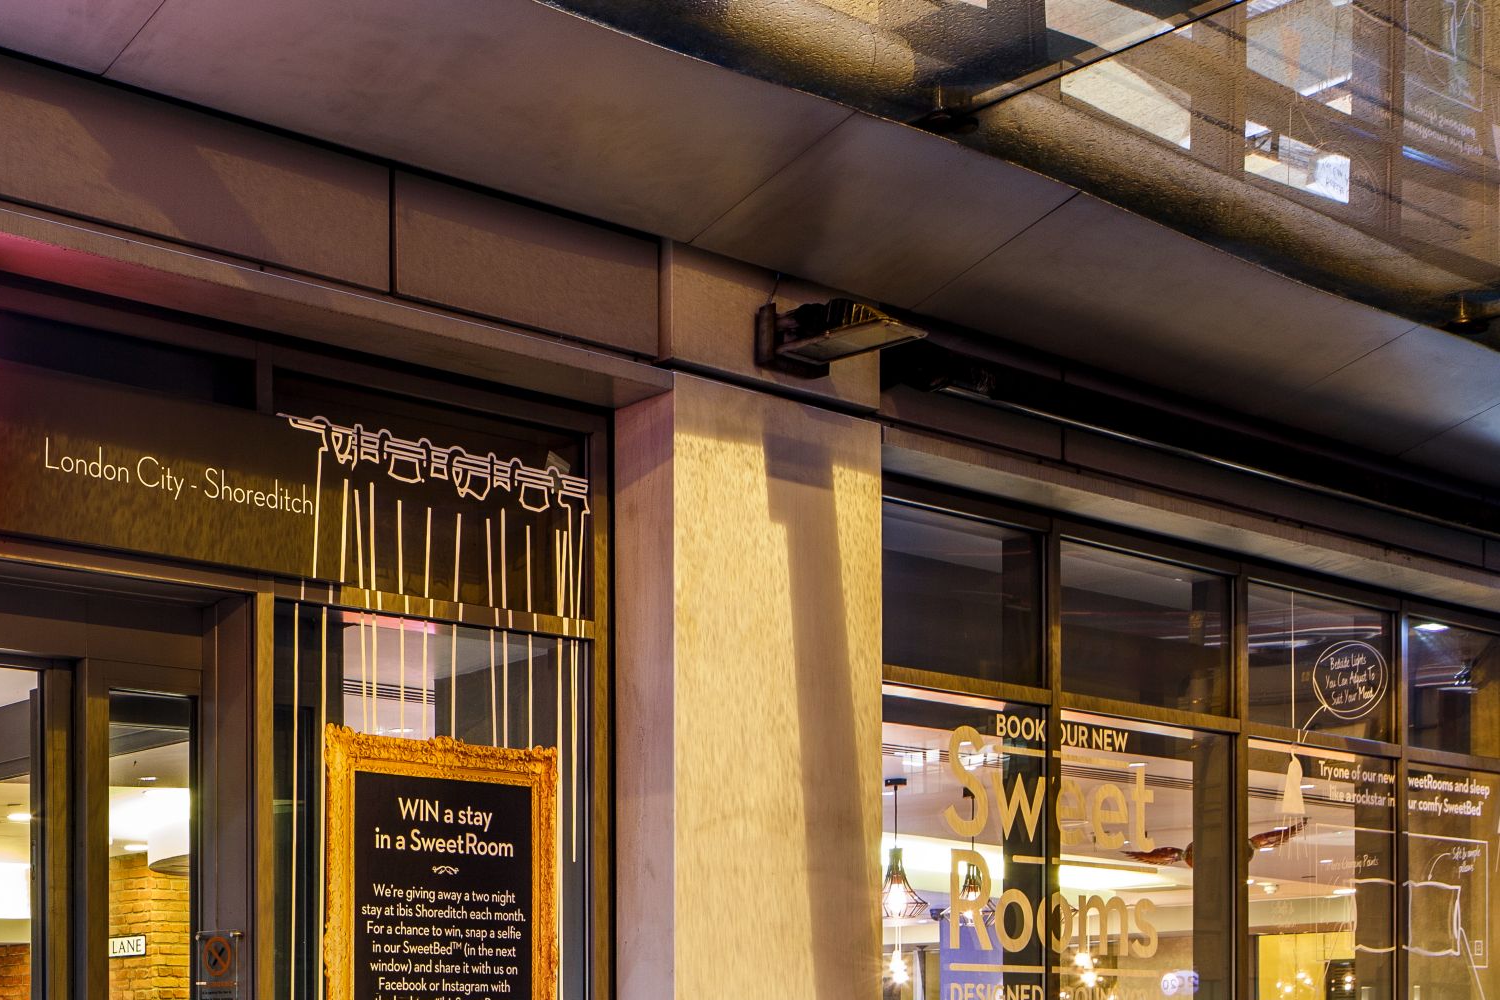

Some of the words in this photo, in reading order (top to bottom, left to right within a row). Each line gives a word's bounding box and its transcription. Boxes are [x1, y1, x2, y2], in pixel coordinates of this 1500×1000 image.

[45, 437, 130, 483] London
[137, 457, 184, 500] City
[204, 469, 314, 516] Shoreditch
[1352, 653, 1367, 672] Lights
[1325, 675, 1336, 689] You
[996, 714, 1046, 742] BOOK
[1060, 721, 1088, 748] OUR
[1092, 728, 1128, 752] NEW
[944, 725, 1155, 852] Sweet
[1319, 760, 1333, 780] Try
[1333, 768, 1350, 780] one
[1351, 765, 1361, 780] of
[1362, 772, 1377, 783] our
[1378, 773, 1395, 784] new
[1408, 775, 1453, 793] weetRooms
[1454, 778, 1469, 793] and
[1470, 779, 1490, 799] sleep
[1329, 785, 1344, 802] like
[1354, 789, 1386, 807] rockstar
[1419, 800, 1442, 816] comfy
[398, 798, 438, 822] WIN
[444, 809, 453, 823] a
[458, 806, 492, 832] stay
[375, 827, 390, 849] in
[396, 836, 405, 850] a
[410, 829, 513, 857] SweetRoom
[373, 884, 403, 897] We're
[406, 886, 435, 902] giving
[438, 892, 462, 904] away
[464, 893, 469, 901] a
[472, 891, 489, 902] two
[492, 890, 515, 906] night
[950, 848, 1159, 959] Rooms
[362, 904, 382, 918] stay
[384, 905, 394, 916] at
[397, 903, 413, 916] ibis
[416, 904, 467, 918] Shoreditch
[470, 907, 492, 920] each
[494, 909, 526, 921] month.
[367, 921, 384, 934] For
[387, 926, 392, 934] a
[395, 922, 429, 936] chance
[432, 926, 442, 936] to
[445, 925, 463, 938] win,
[466, 929, 487, 941] snap
[490, 930, 494, 938] a
[498, 926, 521, 939] selfie
[112, 939, 142, 955] LANE
[373, 940, 381, 952] in
[384, 944, 400, 953] our
[464, 943, 475, 957] (in
[478, 943, 493, 956] the
[496, 947, 516, 957] next
[370, 958, 412, 974] window)
[414, 959, 432, 972] and
[435, 960, 460, 973] share
[463, 962, 469, 973] it
[472, 961, 491, 974] with
[494, 966, 504, 974] us
[379, 977, 427, 990] Facebook
[429, 983, 440, 991] or
[442, 979, 488, 995] Instagram
[491, 980, 510, 992] with
